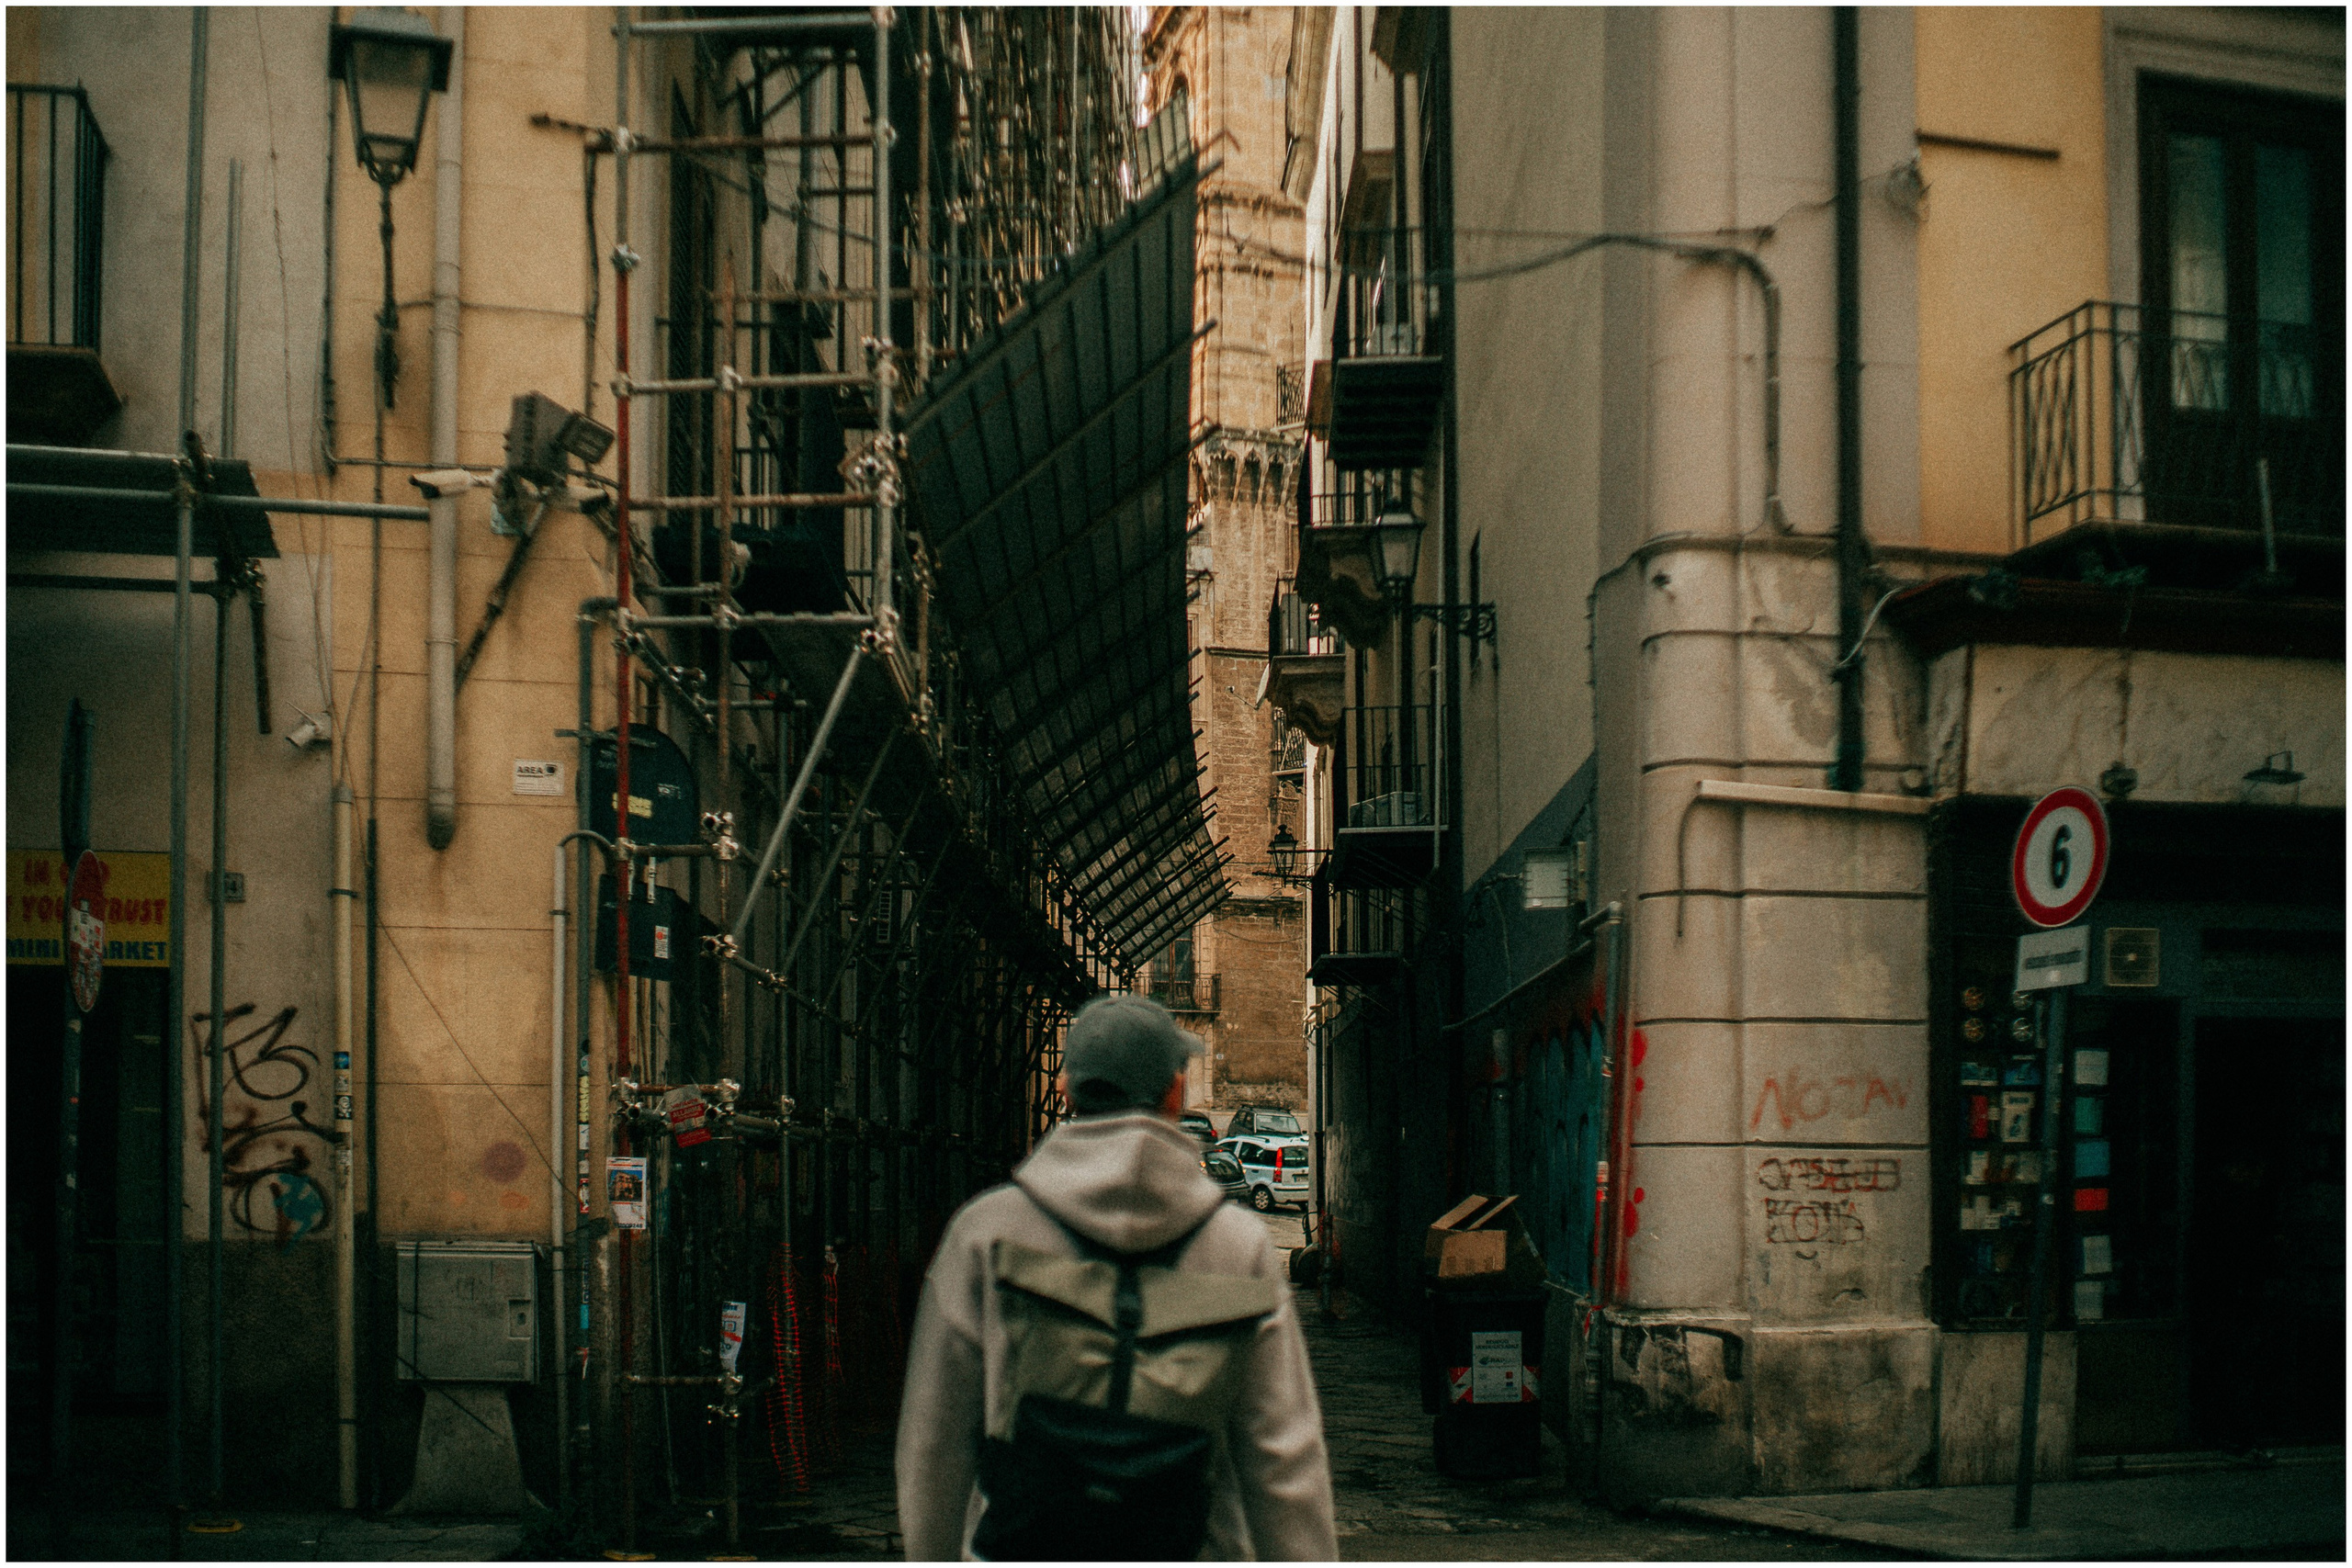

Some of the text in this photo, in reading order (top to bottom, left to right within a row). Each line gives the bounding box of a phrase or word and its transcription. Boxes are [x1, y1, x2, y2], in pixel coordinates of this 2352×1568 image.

[516, 766, 544, 774] AREA
[2051, 824, 2073, 889] 6
[24, 859, 50, 886] IN
[103, 941, 167, 961] RKET
